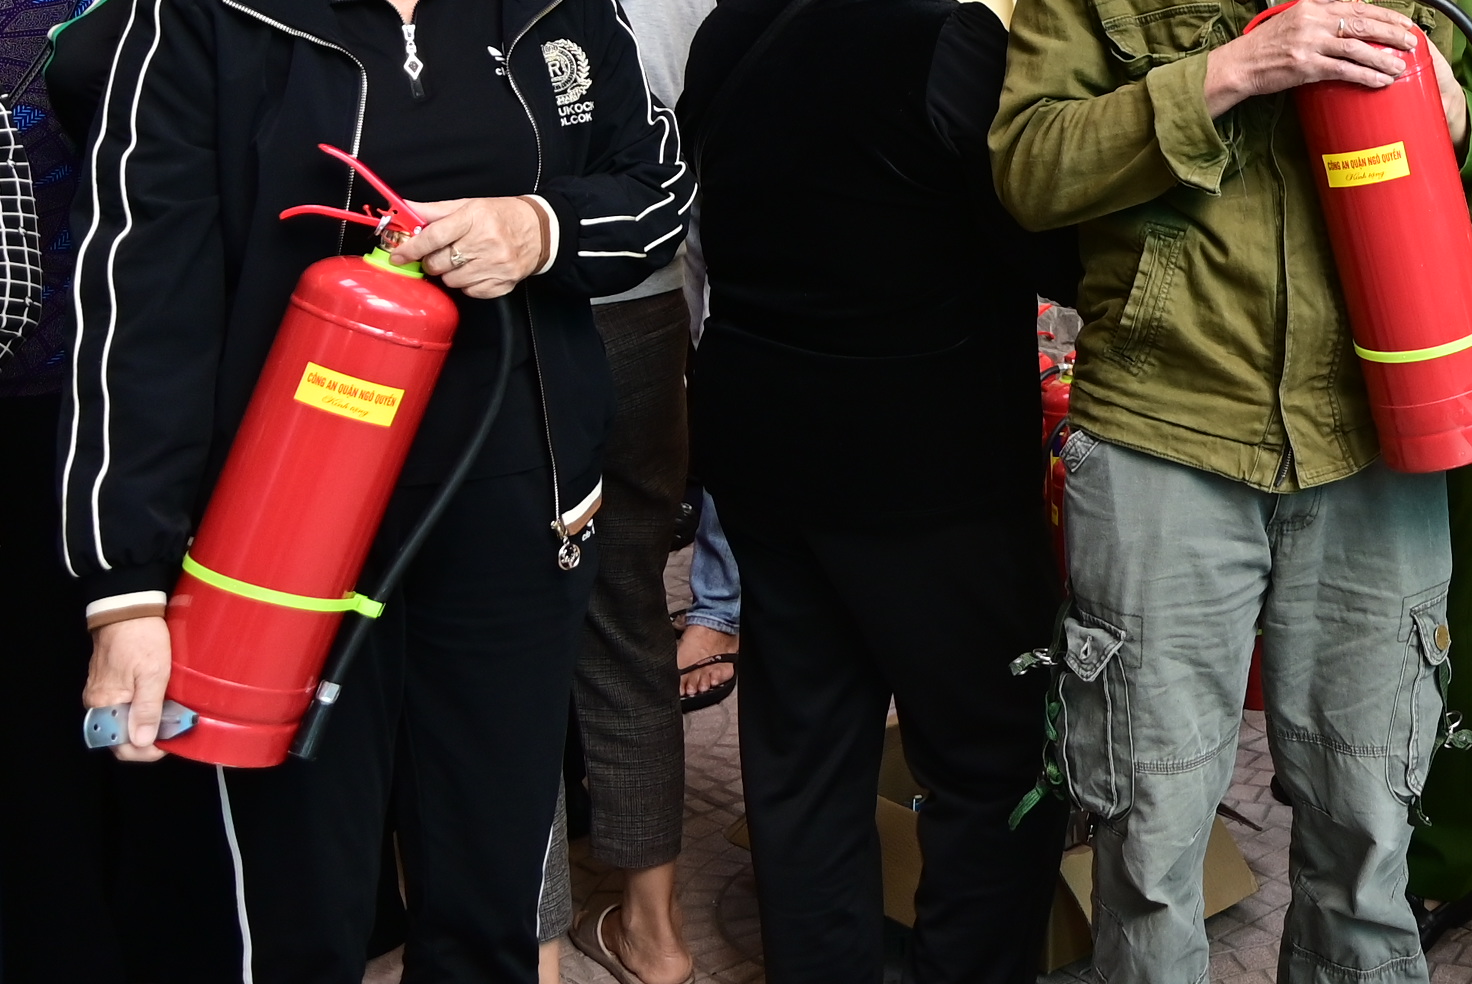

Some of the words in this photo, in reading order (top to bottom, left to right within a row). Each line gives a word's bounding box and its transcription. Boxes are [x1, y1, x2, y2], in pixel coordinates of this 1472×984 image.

[1342, 160, 1350, 170] AN
[307, 372, 326, 387] CÔNG
[326, 379, 338, 391] AN
[338, 383, 359, 398] QUẬN
